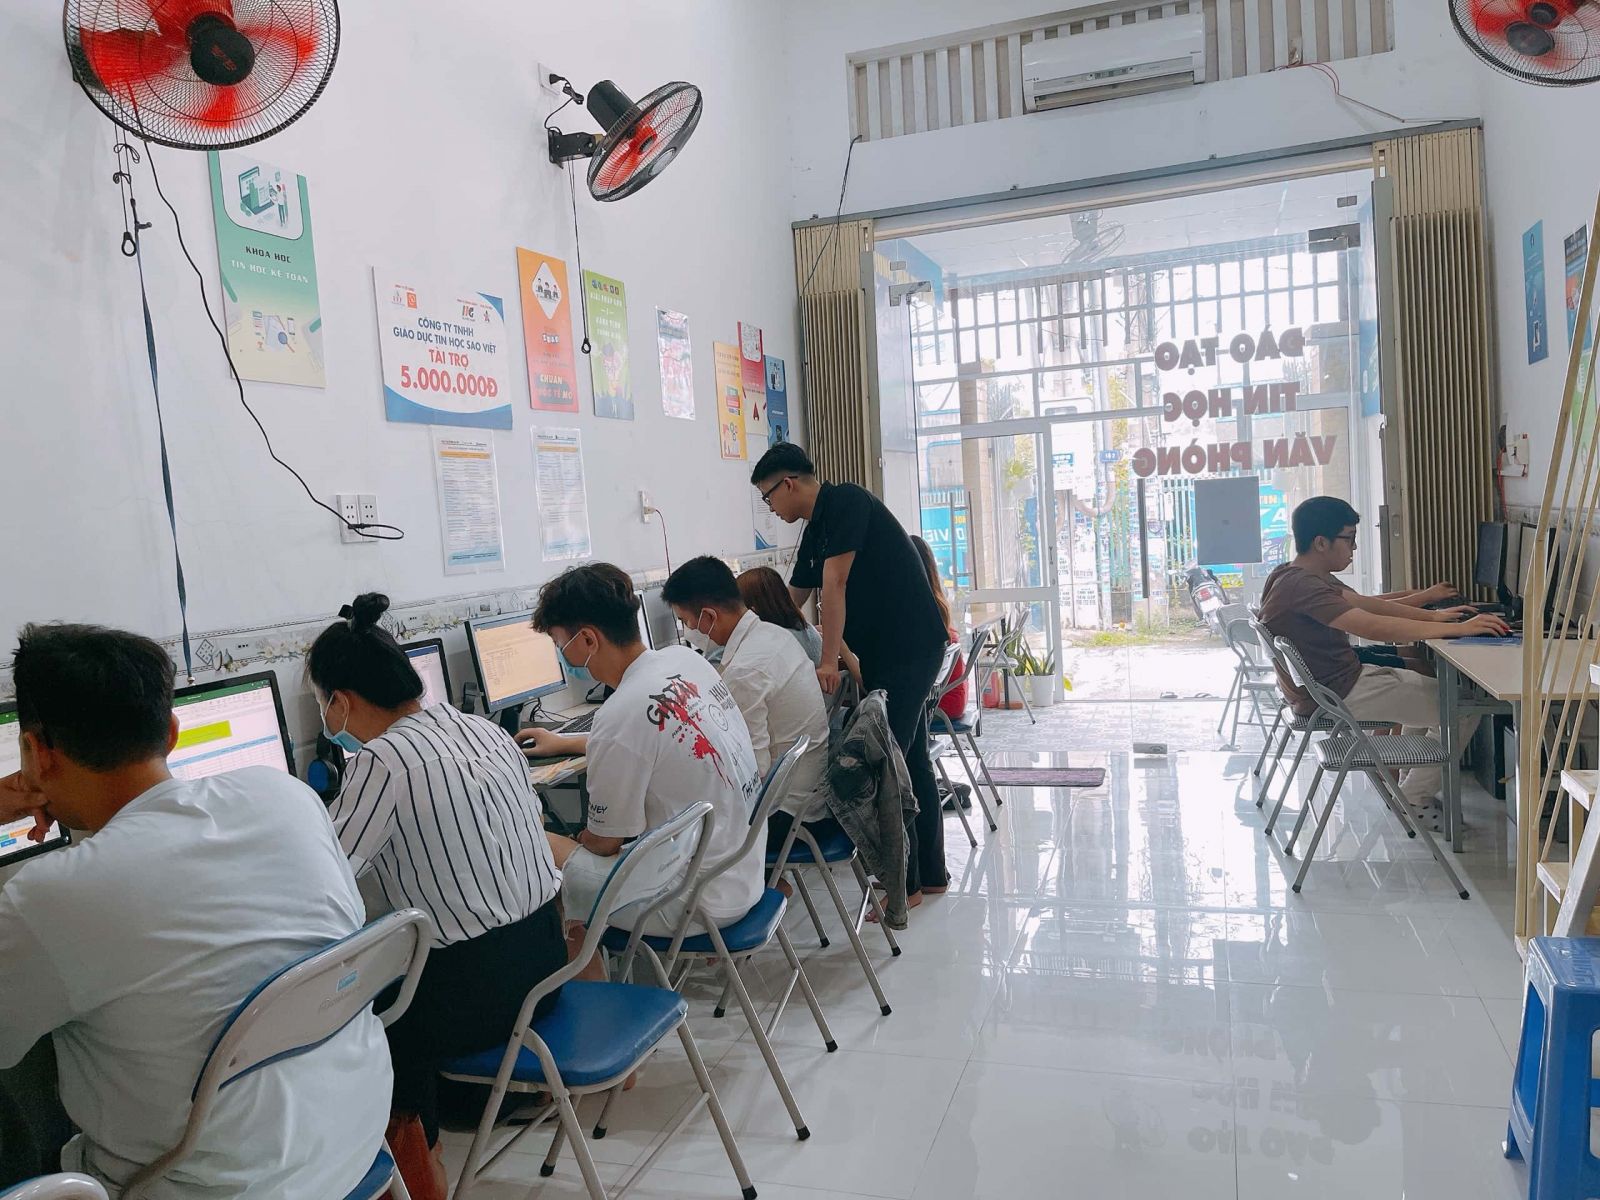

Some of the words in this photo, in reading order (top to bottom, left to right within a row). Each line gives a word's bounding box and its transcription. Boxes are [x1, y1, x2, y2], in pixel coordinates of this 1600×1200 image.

[418, 317, 441, 331] CÔNG
[443, 322, 453, 333] TY
[453, 325, 474, 337] TNHH
[416, 331, 433, 344] DỤC
[434, 334, 447, 346] TIN
[448, 337, 465, 349] HỌC
[466, 340, 481, 351] SAO
[482, 342, 497, 355] VIỆT
[429, 346, 446, 364] TÀI
[448, 352, 469, 371] TRỢ
[400, 365, 498, 398] 5.000.000Đ
